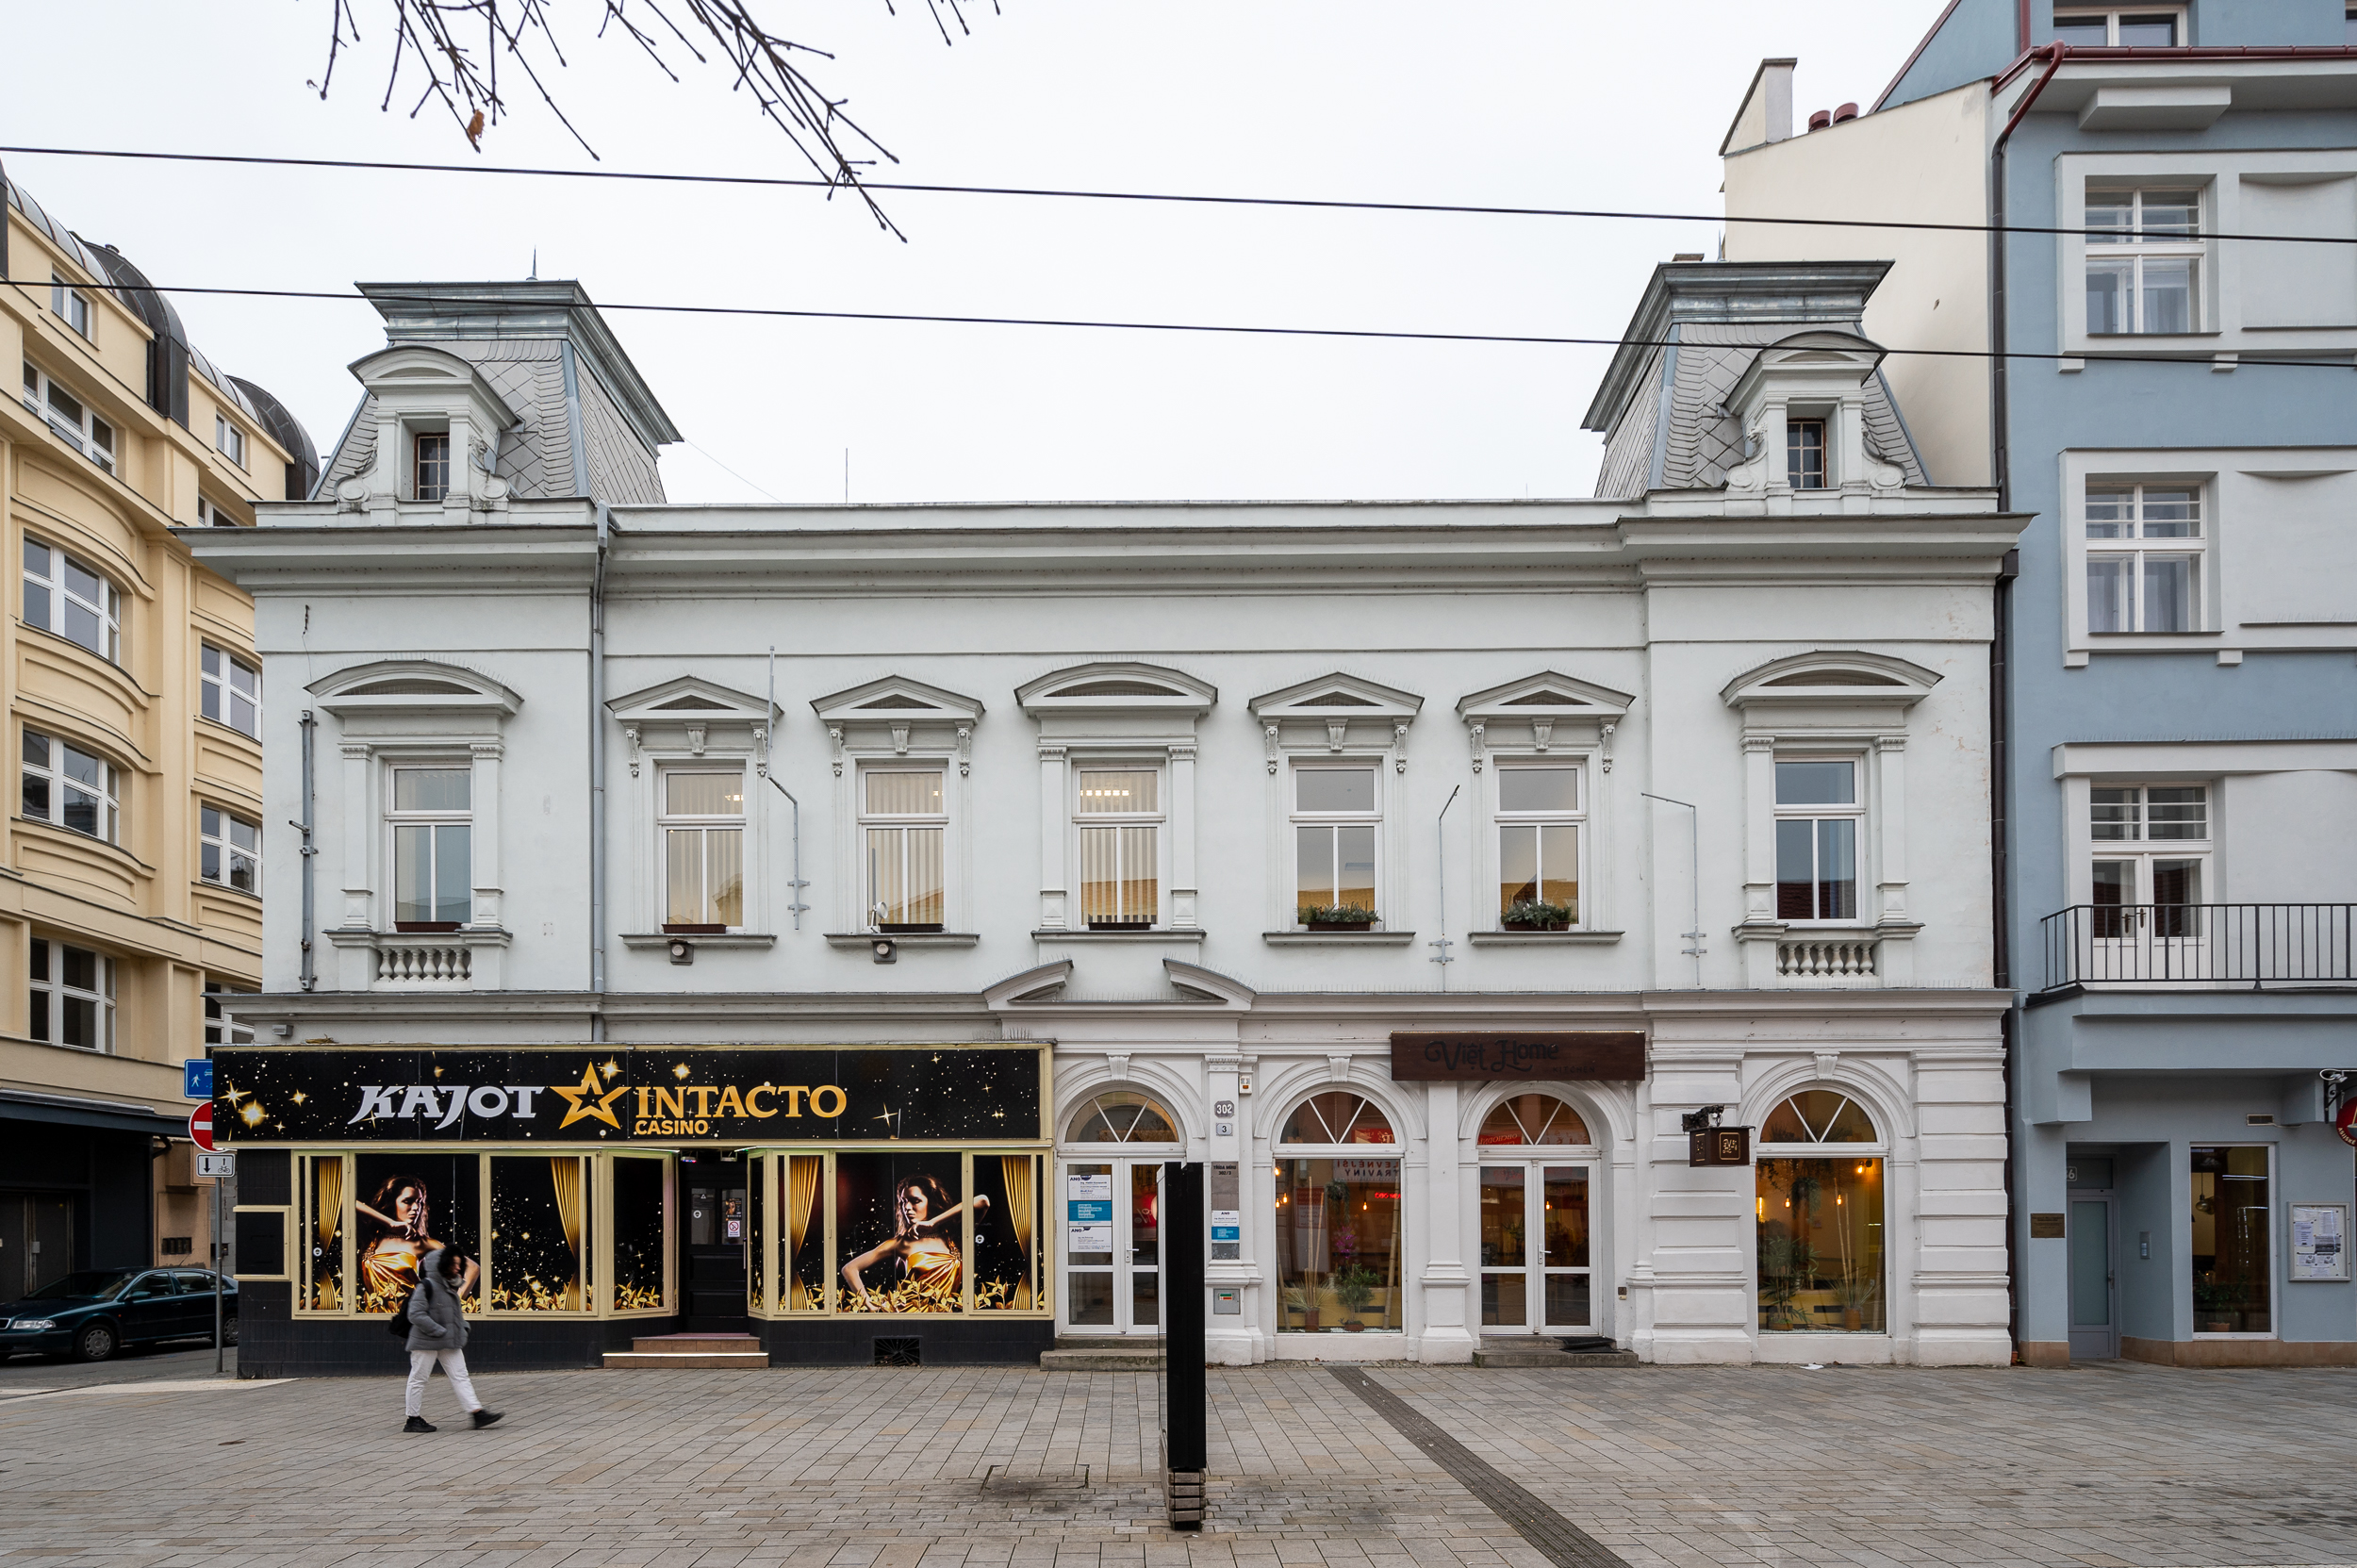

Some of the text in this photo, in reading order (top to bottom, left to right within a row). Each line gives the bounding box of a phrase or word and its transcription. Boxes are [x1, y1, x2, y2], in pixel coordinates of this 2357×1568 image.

[1491, 1039, 1559, 1072] Home
[348, 1084, 847, 1130] KAJOT INTACTO
[1216, 1104, 1232, 1114] 302
[635, 1119, 709, 1135] CASINO
[1222, 1125, 1228, 1133] 3
